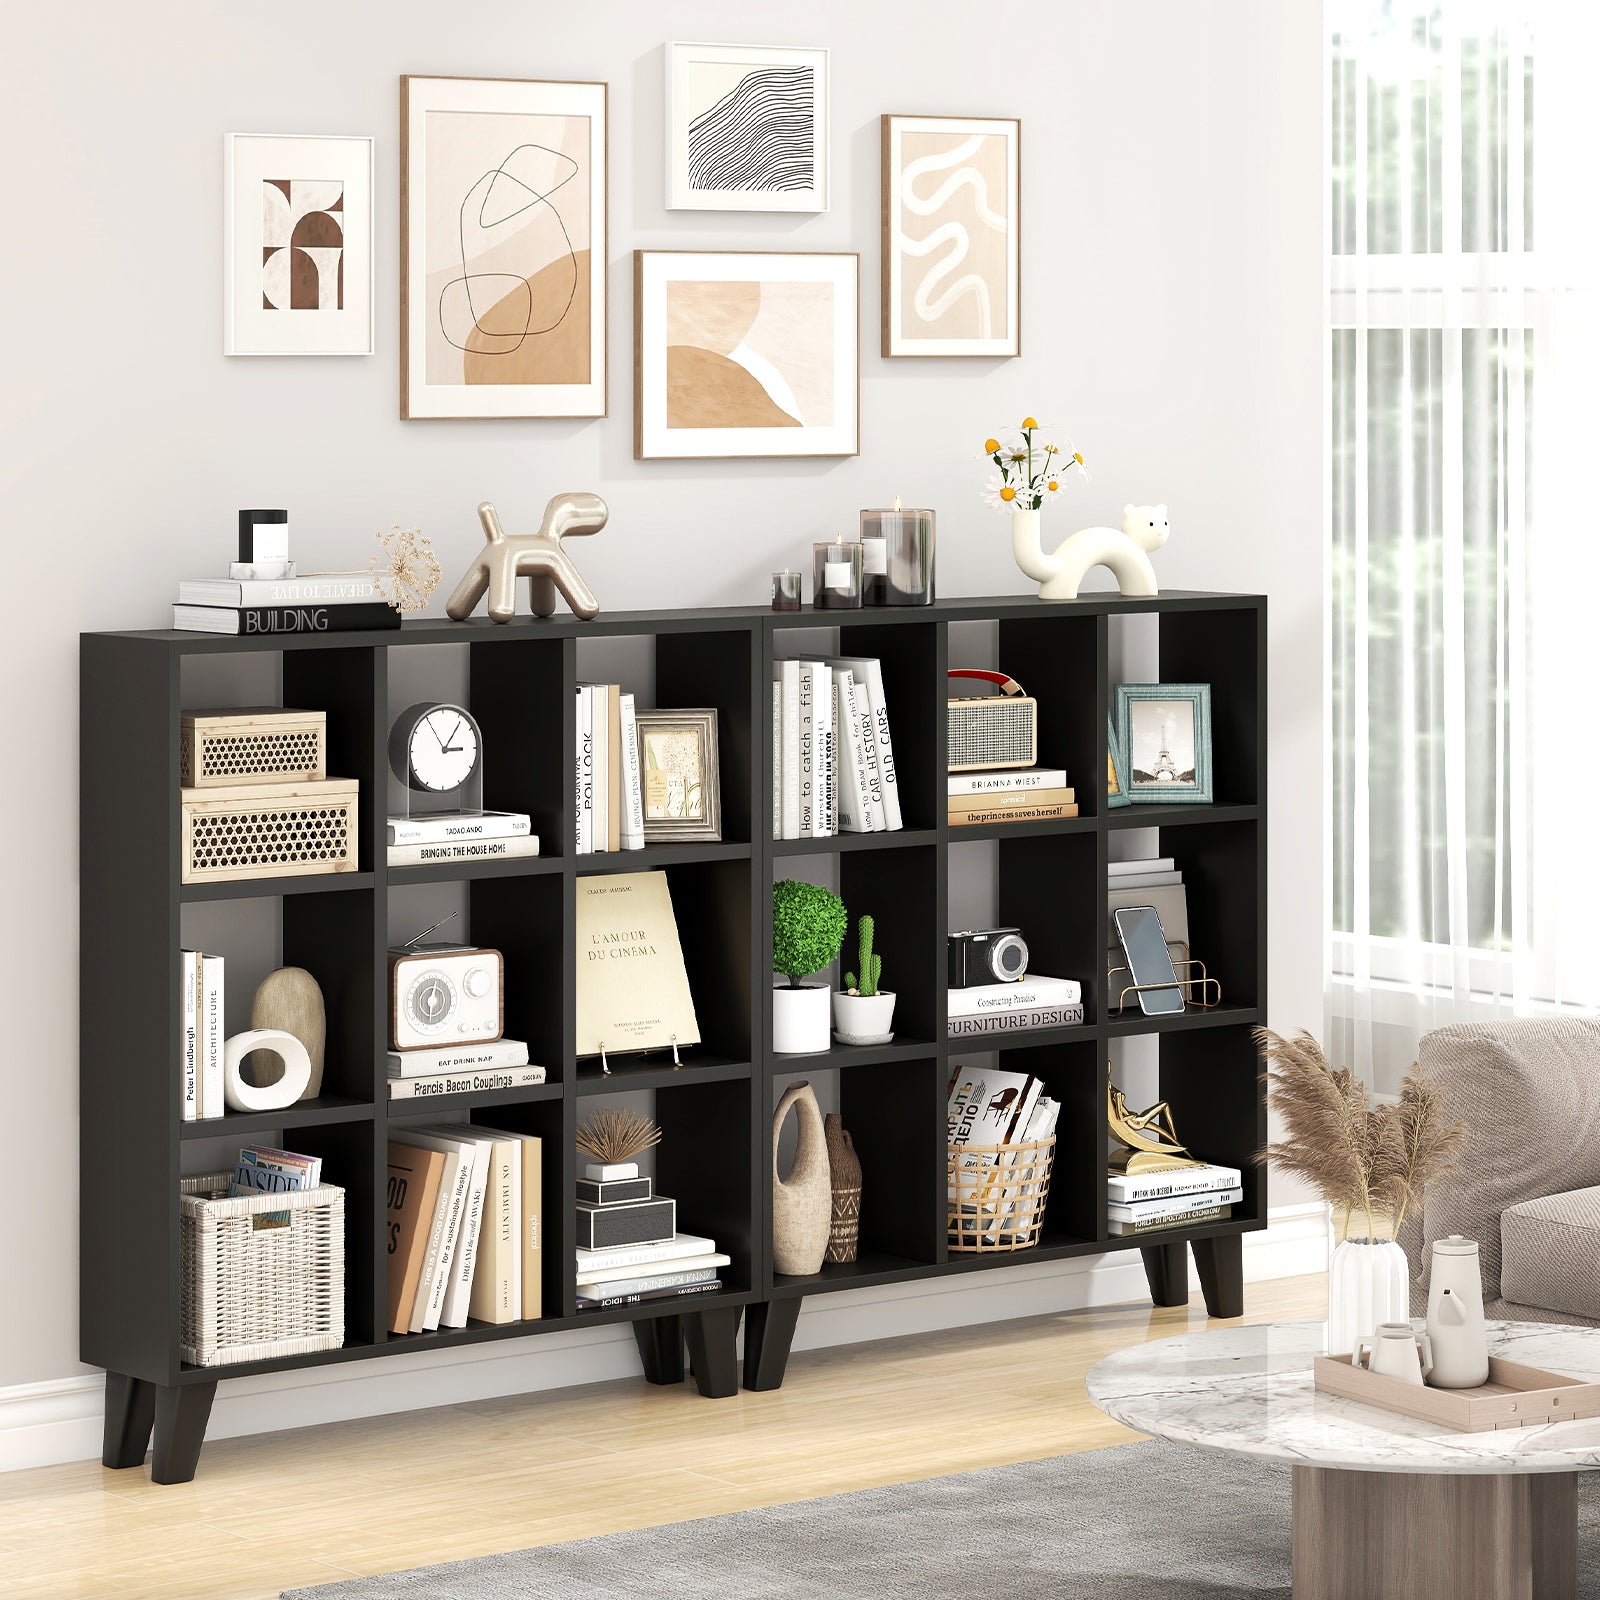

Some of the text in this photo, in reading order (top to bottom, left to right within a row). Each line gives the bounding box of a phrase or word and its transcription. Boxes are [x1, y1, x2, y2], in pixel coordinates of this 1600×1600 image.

[271, 583, 373, 600] CREATE TO LIVE
[246, 609, 329, 633] BUILDING
[801, 675, 811, 707] fish
[846, 674, 857, 717] children
[628, 723, 638, 770] CENTENNIAL
[801, 732, 811, 773] catch
[877, 707, 896, 783] OLD CARS
[860, 712, 882, 803] CAR HISTORY
[584, 733, 592, 810] POLLOCK
[801, 782, 811, 798] to
[972, 777, 1041, 789] BRIANNA WIEST
[631, 798, 641, 828] IRVING
[801, 806, 811, 831] How
[968, 807, 1063, 823] the princess saves herself
[446, 825, 483, 835] TADAO ANDO
[420, 843, 506, 860] BRINGING THE HOUSE HOME
[592, 930, 647, 945] L'AMOUR
[588, 950, 606, 961] DU
[948, 1008, 1083, 1034] FURNITURE DESIGN
[186, 1026, 196, 1101] Peter Lindbergh
[453, 1057, 476, 1066] DRINK
[414, 1074, 513, 1096] Francis Bacon Couplings
[503, 1165, 509, 1180] ON
[441, 1252, 450, 1264] for
[447, 1198, 460, 1243] sustainable
[456, 1165, 468, 1197] lifestyle
[471, 1188, 482, 1219] AWAKE
[432, 1221, 443, 1247] GOOD
[468, 1219, 477, 1238] world
[428, 1256, 435, 1266] IS
[430, 1248, 437, 1256] A
[424, 1266, 434, 1286] THIS
[461, 1249, 473, 1282] DREAM
[638, 1269, 713, 1291] ANNA KARENINA
[601, 1295, 641, 1307] THE IDIOT
